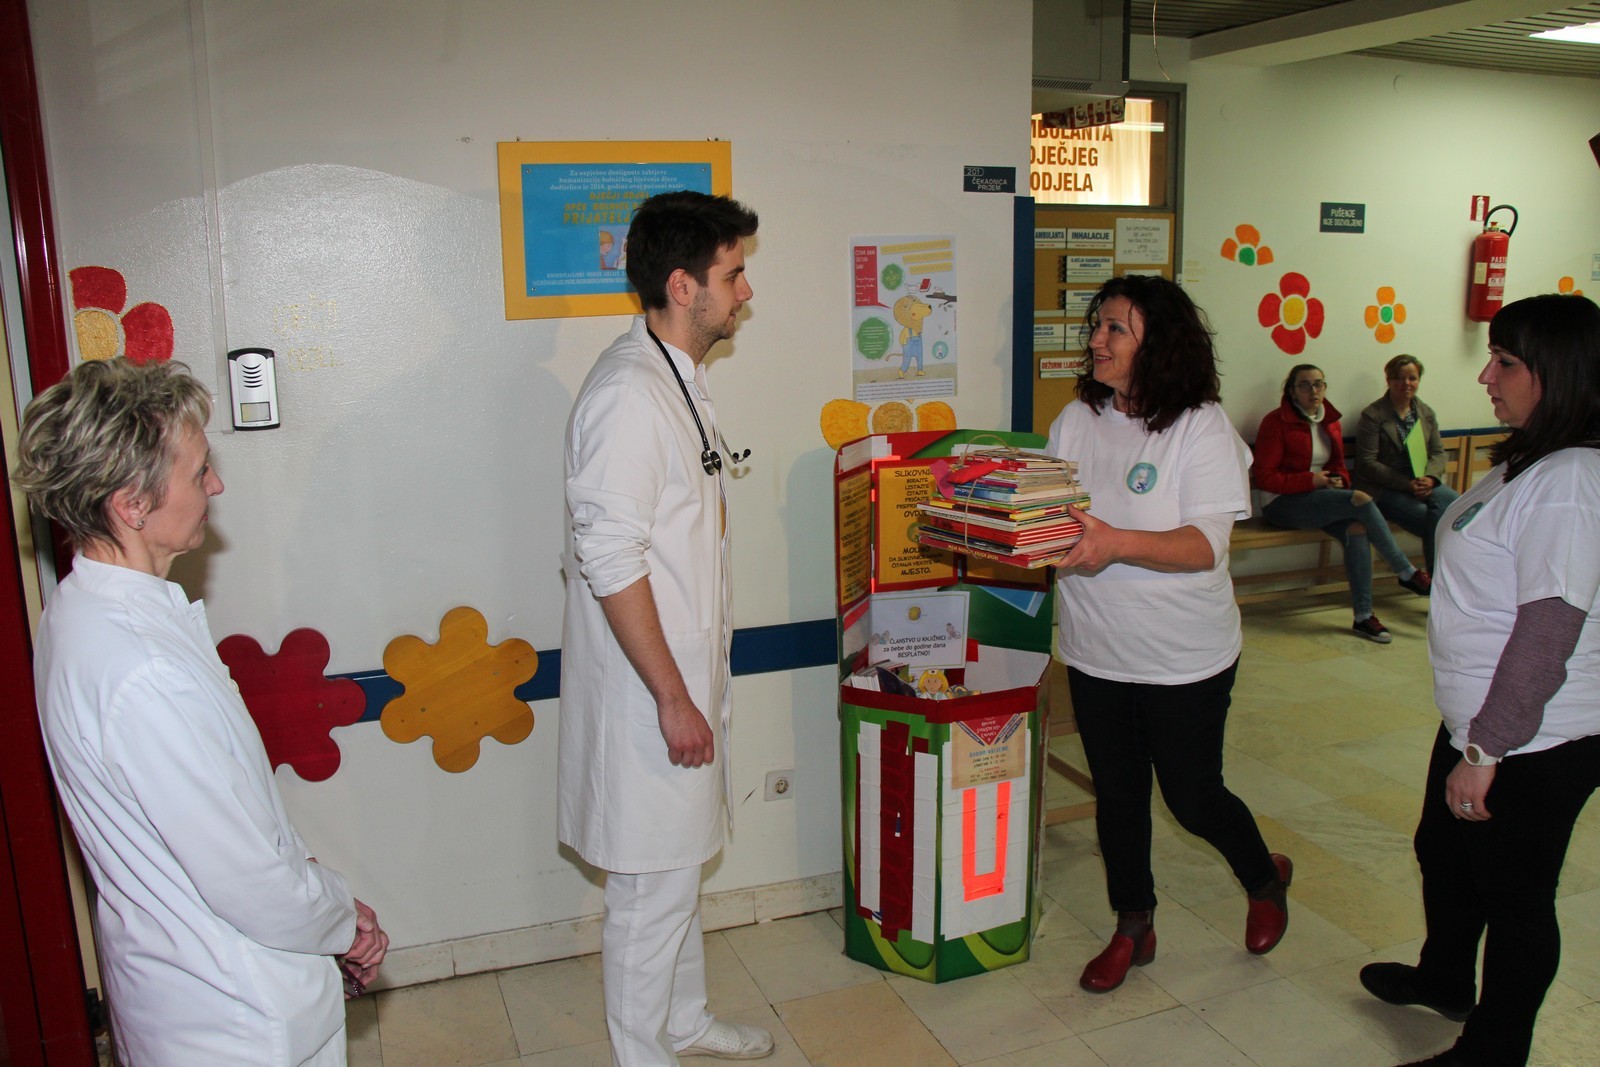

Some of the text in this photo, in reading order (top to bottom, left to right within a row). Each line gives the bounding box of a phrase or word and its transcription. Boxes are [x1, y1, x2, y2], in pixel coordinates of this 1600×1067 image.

[1031, 119, 1113, 141] MBULANTA
[972, 177, 1007, 185] ČEKAONICA
[1030, 171, 1093, 192] ODJELA
[1331, 208, 1355, 218] PUŠENJE
[895, 469, 932, 477] SLIKOVNI
